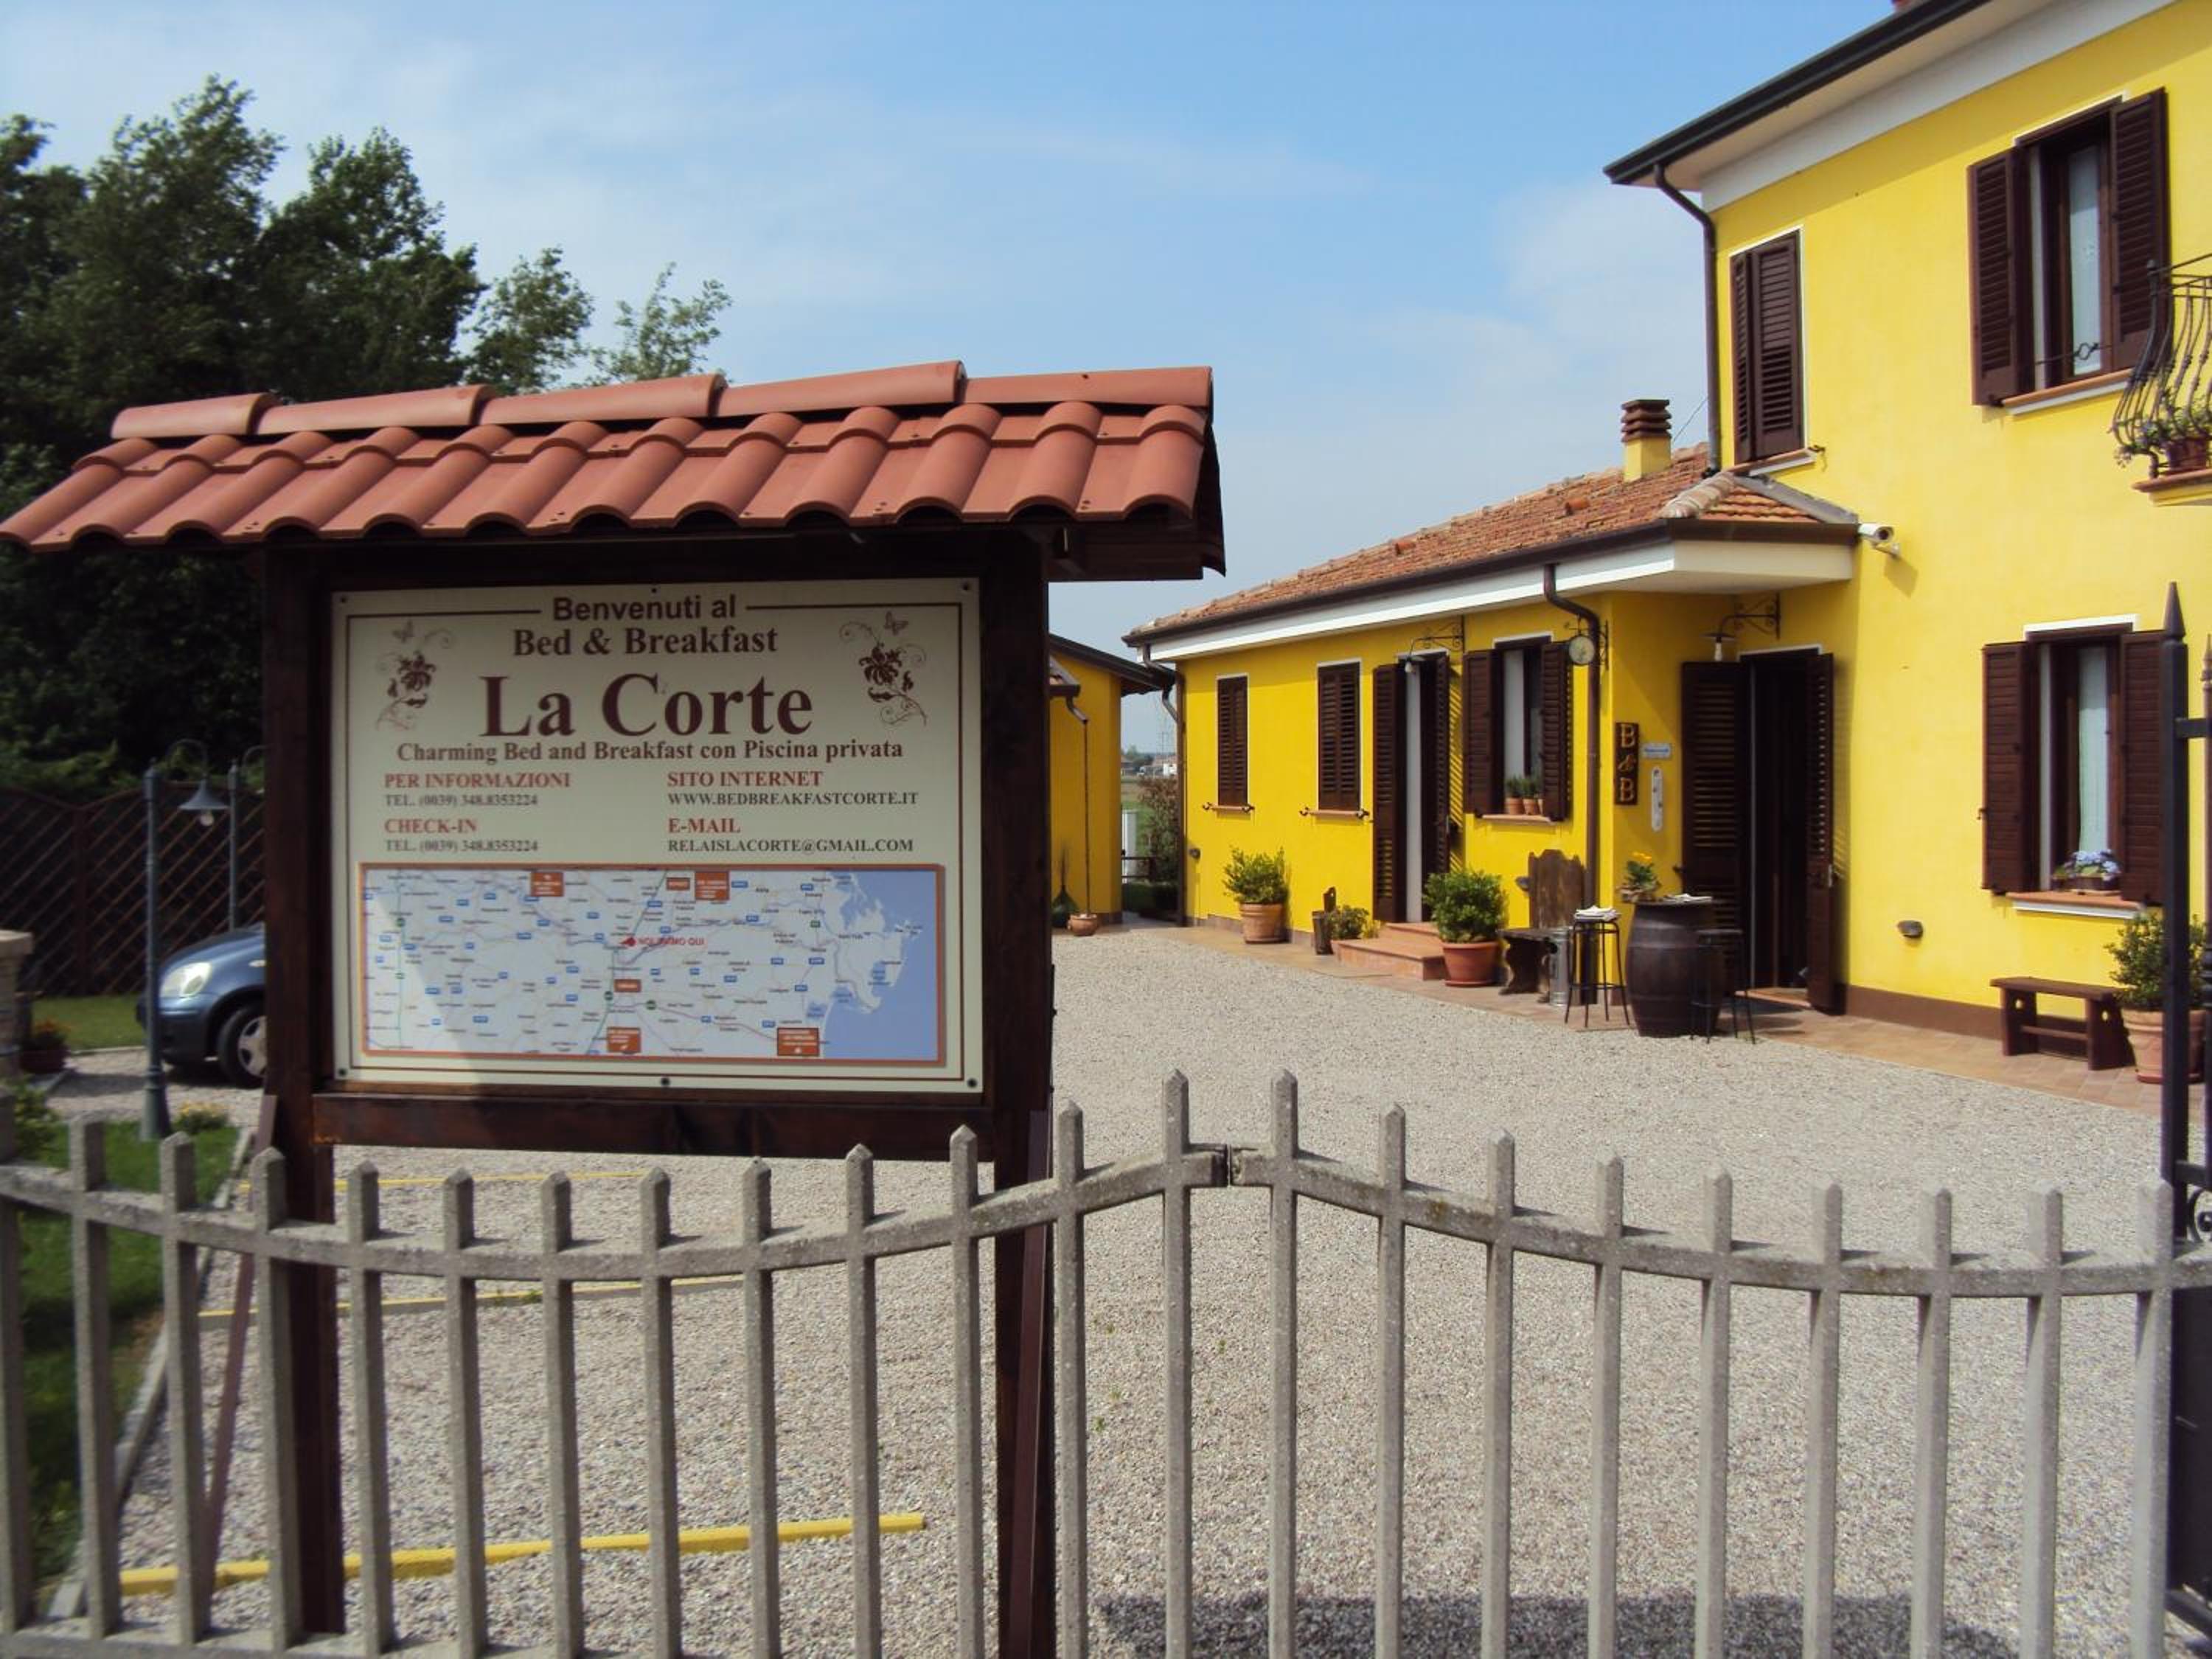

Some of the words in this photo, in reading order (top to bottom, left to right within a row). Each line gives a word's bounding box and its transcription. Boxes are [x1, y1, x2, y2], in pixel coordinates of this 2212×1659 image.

[552, 594, 701, 622] Benvenuti
[711, 594, 737, 619] al
[513, 628, 571, 656] Bed
[582, 627, 611, 655] &
[625, 626, 779, 655] Breakfast
[479, 675, 576, 737] La
[601, 672, 813, 737] Corte
[397, 742, 498, 765] Charming
[504, 742, 542, 760] Bed
[548, 741, 586, 760] and
[594, 740, 693, 759] Breakfast
[700, 745, 737, 759] con
[745, 740, 818, 759] Piscina
[825, 738, 902, 764] privata
[385, 773, 420, 788] PER
[425, 772, 571, 788] INFORMAZIONI
[667, 771, 714, 787] SITO
[720, 771, 824, 787] INTERNET
[385, 793, 415, 807] TEL.
[419, 794, 458, 807] (0039)
[667, 791, 919, 806] WWW.BEDBREAKFASTCORTE.IT
[384, 818, 477, 834] CHECK-IN
[669, 818, 741, 834] E-MAIL
[386, 839, 415, 852] TEL.
[419, 839, 459, 852] (0039)
[668, 838, 914, 852] RELAISLACORTE@GMAIL.COM
